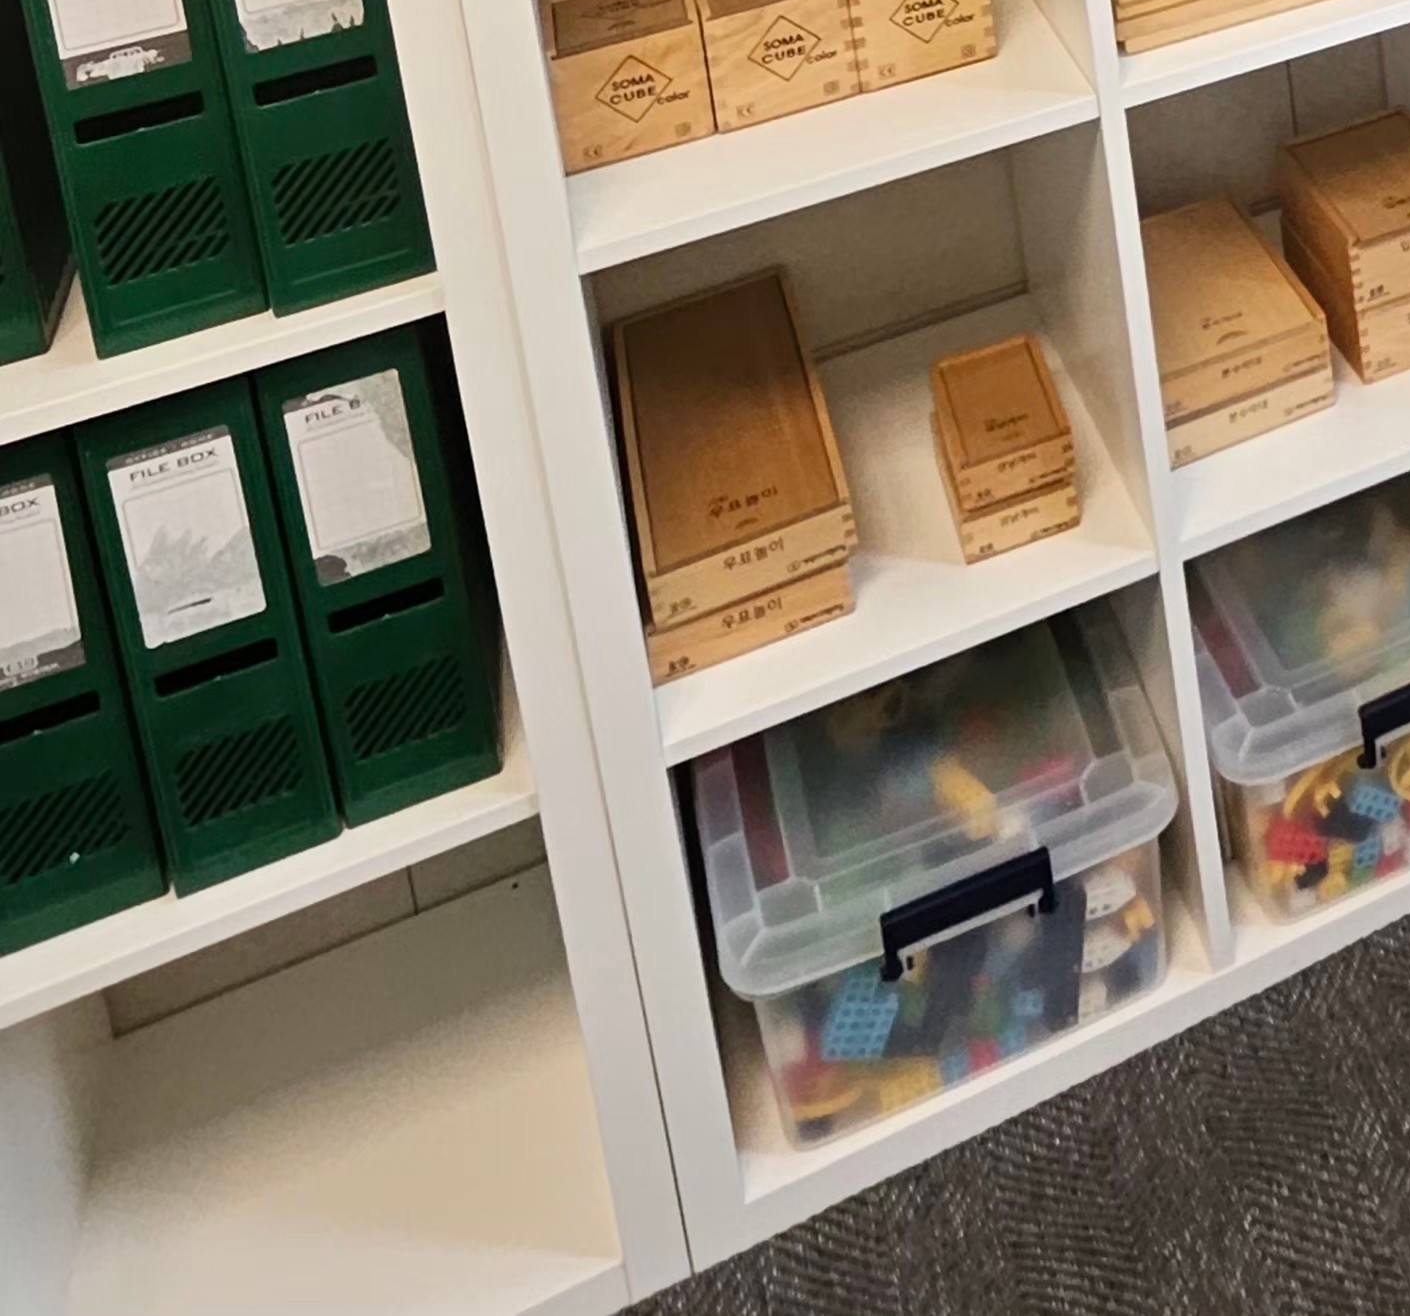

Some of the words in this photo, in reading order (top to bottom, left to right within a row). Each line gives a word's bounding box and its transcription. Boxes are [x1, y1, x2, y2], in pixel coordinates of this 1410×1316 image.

[902, 8, 945, 26] CUBE
[763, 33, 805, 51] SOMA
[761, 45, 806, 64] CUBE
[806, 49, 837, 64] color
[612, 73, 655, 91] SOMA
[610, 86, 657, 105] CUBE
[656, 90, 691, 105] color
[304, 405, 343, 423] FILE
[129, 463, 171, 482] FILE
[177, 447, 218, 466] BOX
